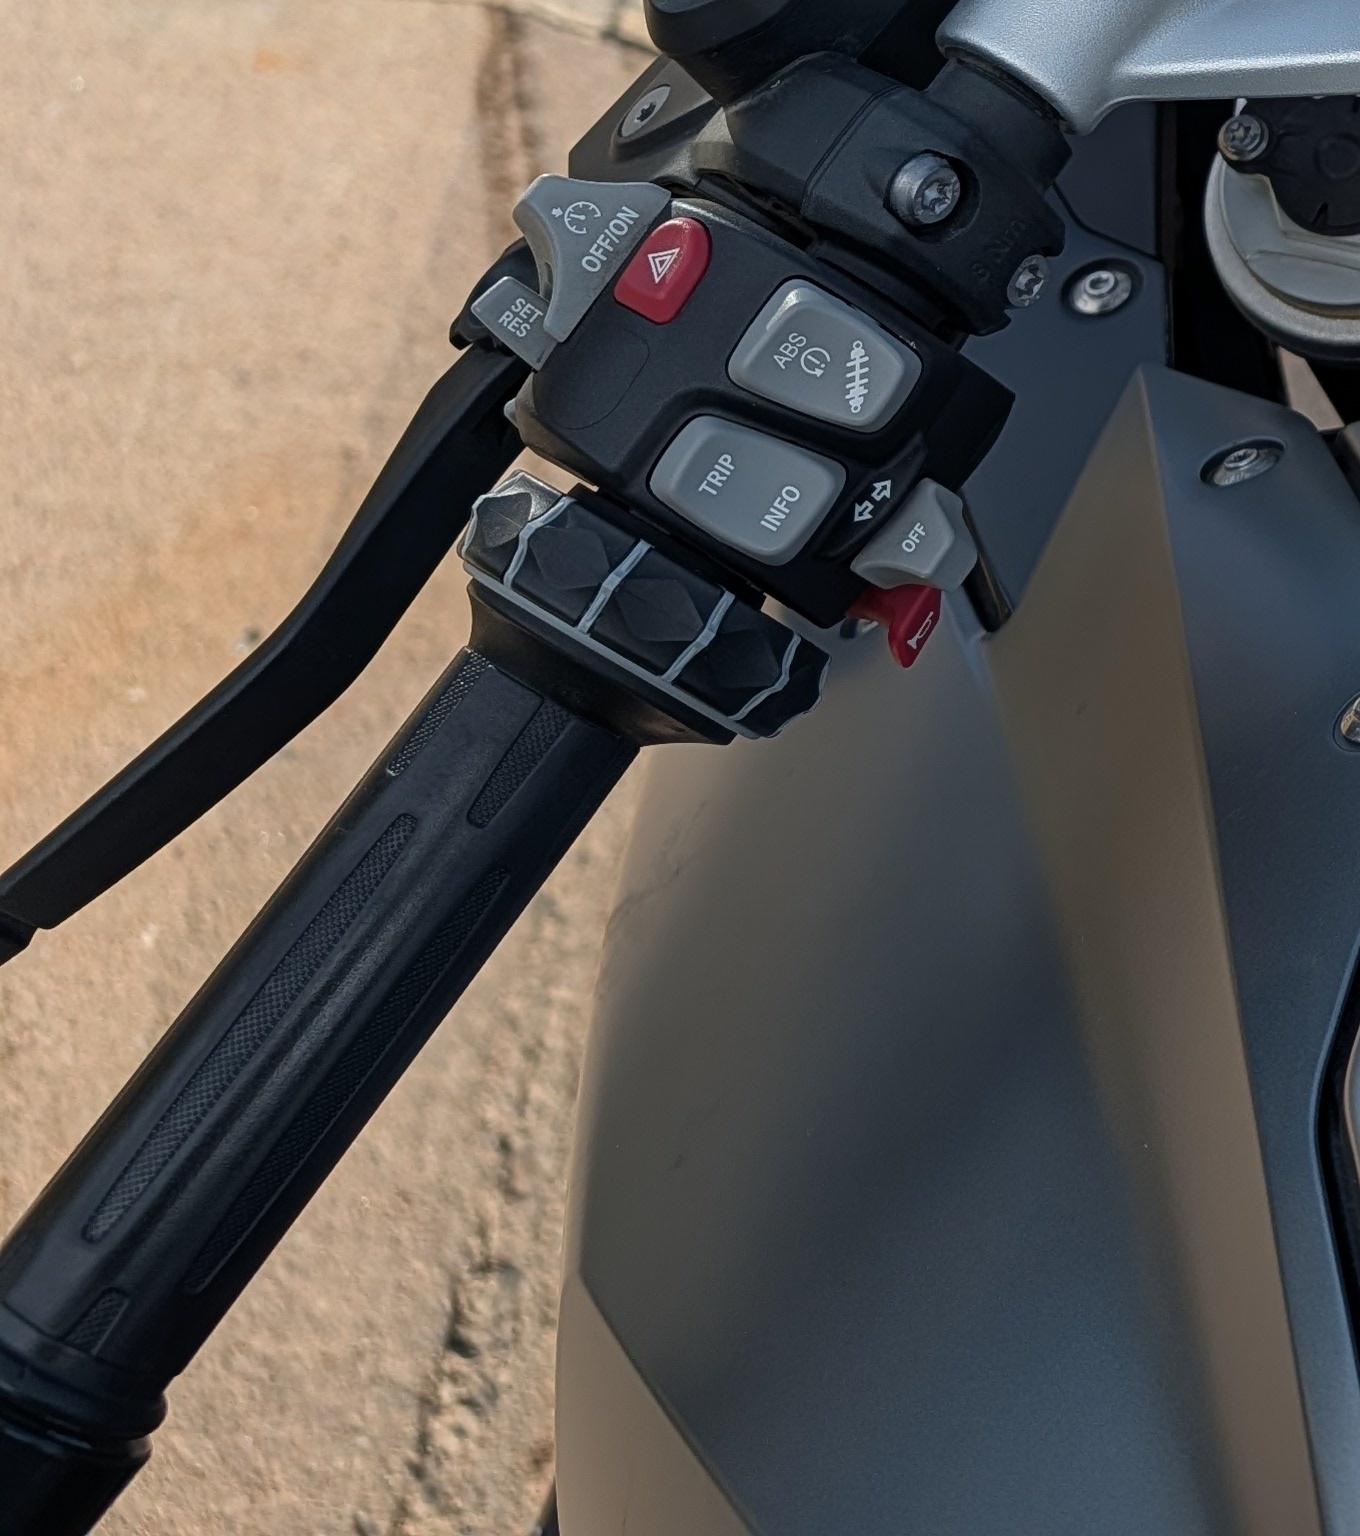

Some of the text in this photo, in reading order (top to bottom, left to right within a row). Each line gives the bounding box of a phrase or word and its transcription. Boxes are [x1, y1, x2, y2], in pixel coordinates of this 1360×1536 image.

[581, 204, 640, 272] OFF/ON
[498, 310, 531, 337] RES
[511, 298, 544, 324] SET
[773, 332, 807, 370] ABS
[698, 453, 735, 496] TRIP
[760, 485, 801, 532] INFO
[901, 522, 926, 553] OFF
